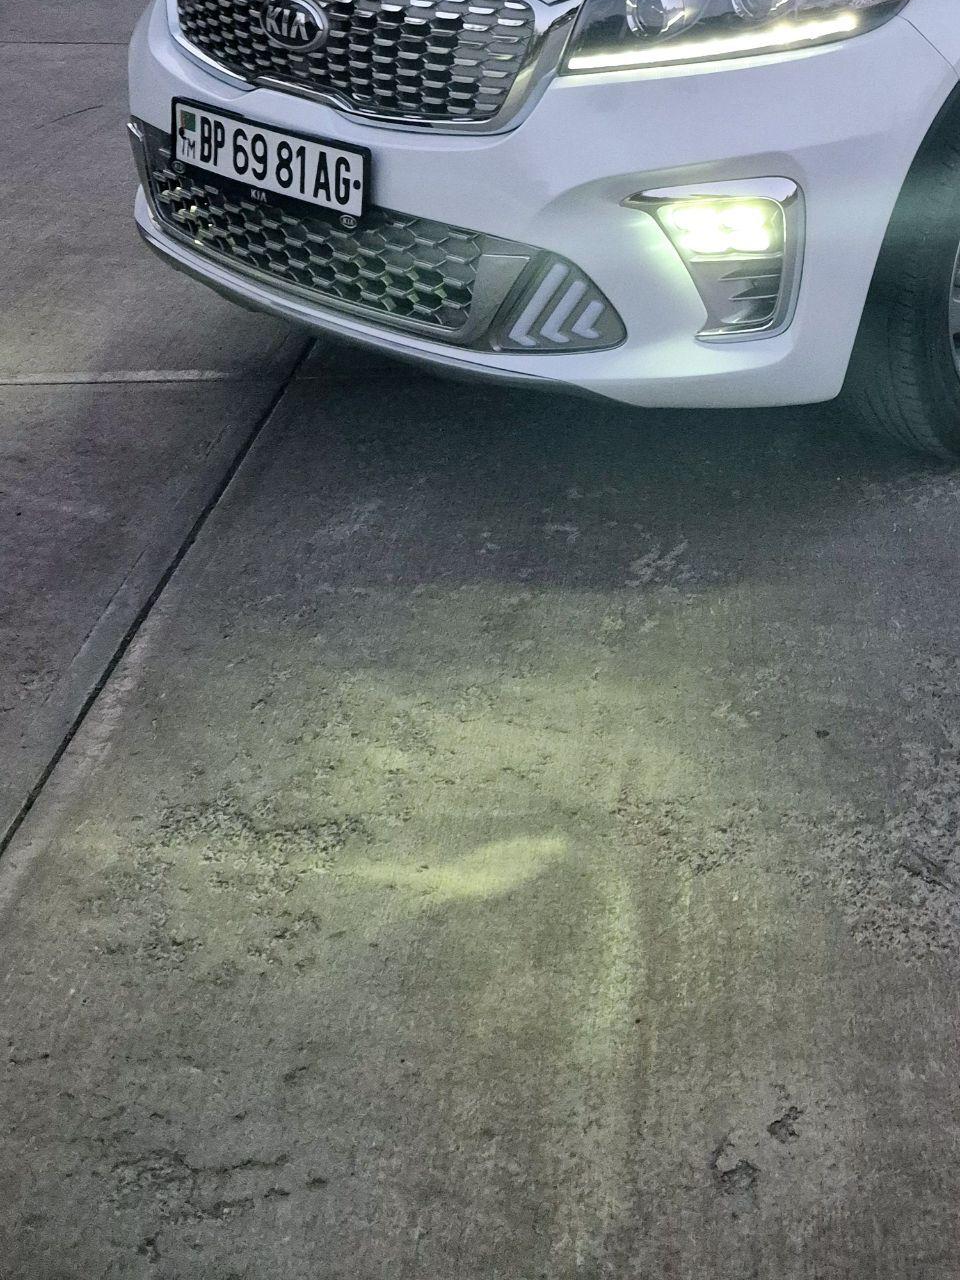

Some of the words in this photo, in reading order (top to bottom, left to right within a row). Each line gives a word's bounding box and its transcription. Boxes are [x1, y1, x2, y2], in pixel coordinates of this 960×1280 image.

[265, 5, 309, 40] KIA
[250, 188, 268, 203] KIA
[312, 150, 351, 206] AG
